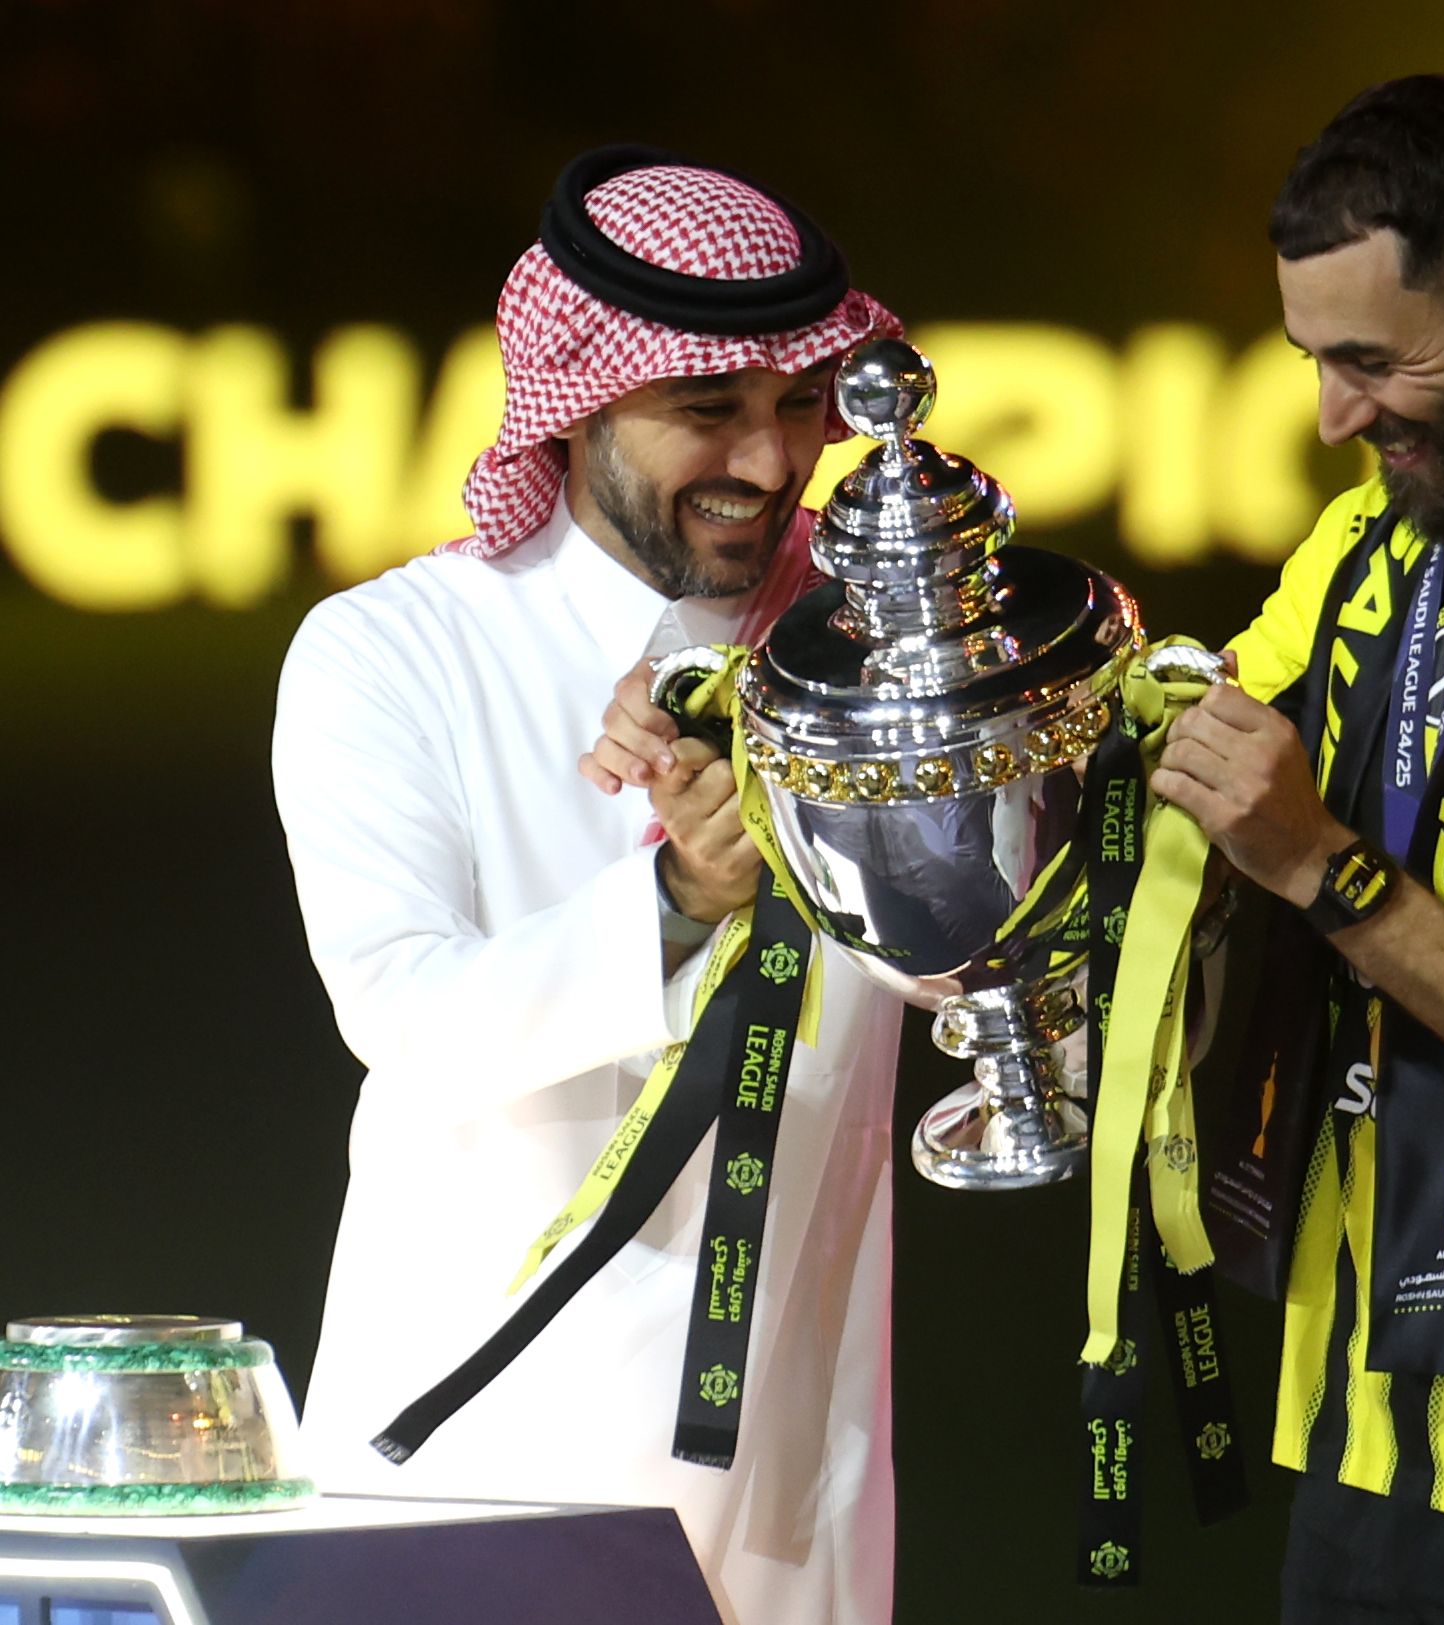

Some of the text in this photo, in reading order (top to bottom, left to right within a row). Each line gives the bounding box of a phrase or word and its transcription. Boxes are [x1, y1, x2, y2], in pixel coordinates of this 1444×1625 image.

[1395, 566, 1435, 788] SAUDI LEAGUE 24/25
[1101, 778, 1125, 862] LEAGUE
[1124, 824, 1135, 862] SAUDI
[736, 1024, 770, 1109] LEAGUE
[761, 1028, 787, 1112] ROSHN SAUDI
[600, 1111, 650, 1180] LEAGUE
[708, 1235, 728, 1321] السعودي
[727, 1238, 752, 1323] دوري روشن
[1190, 1303, 1219, 1382] LEAGUE
[1087, 1418, 1110, 1500] السعودي
[1110, 1419, 1133, 1500] دوري روشن
